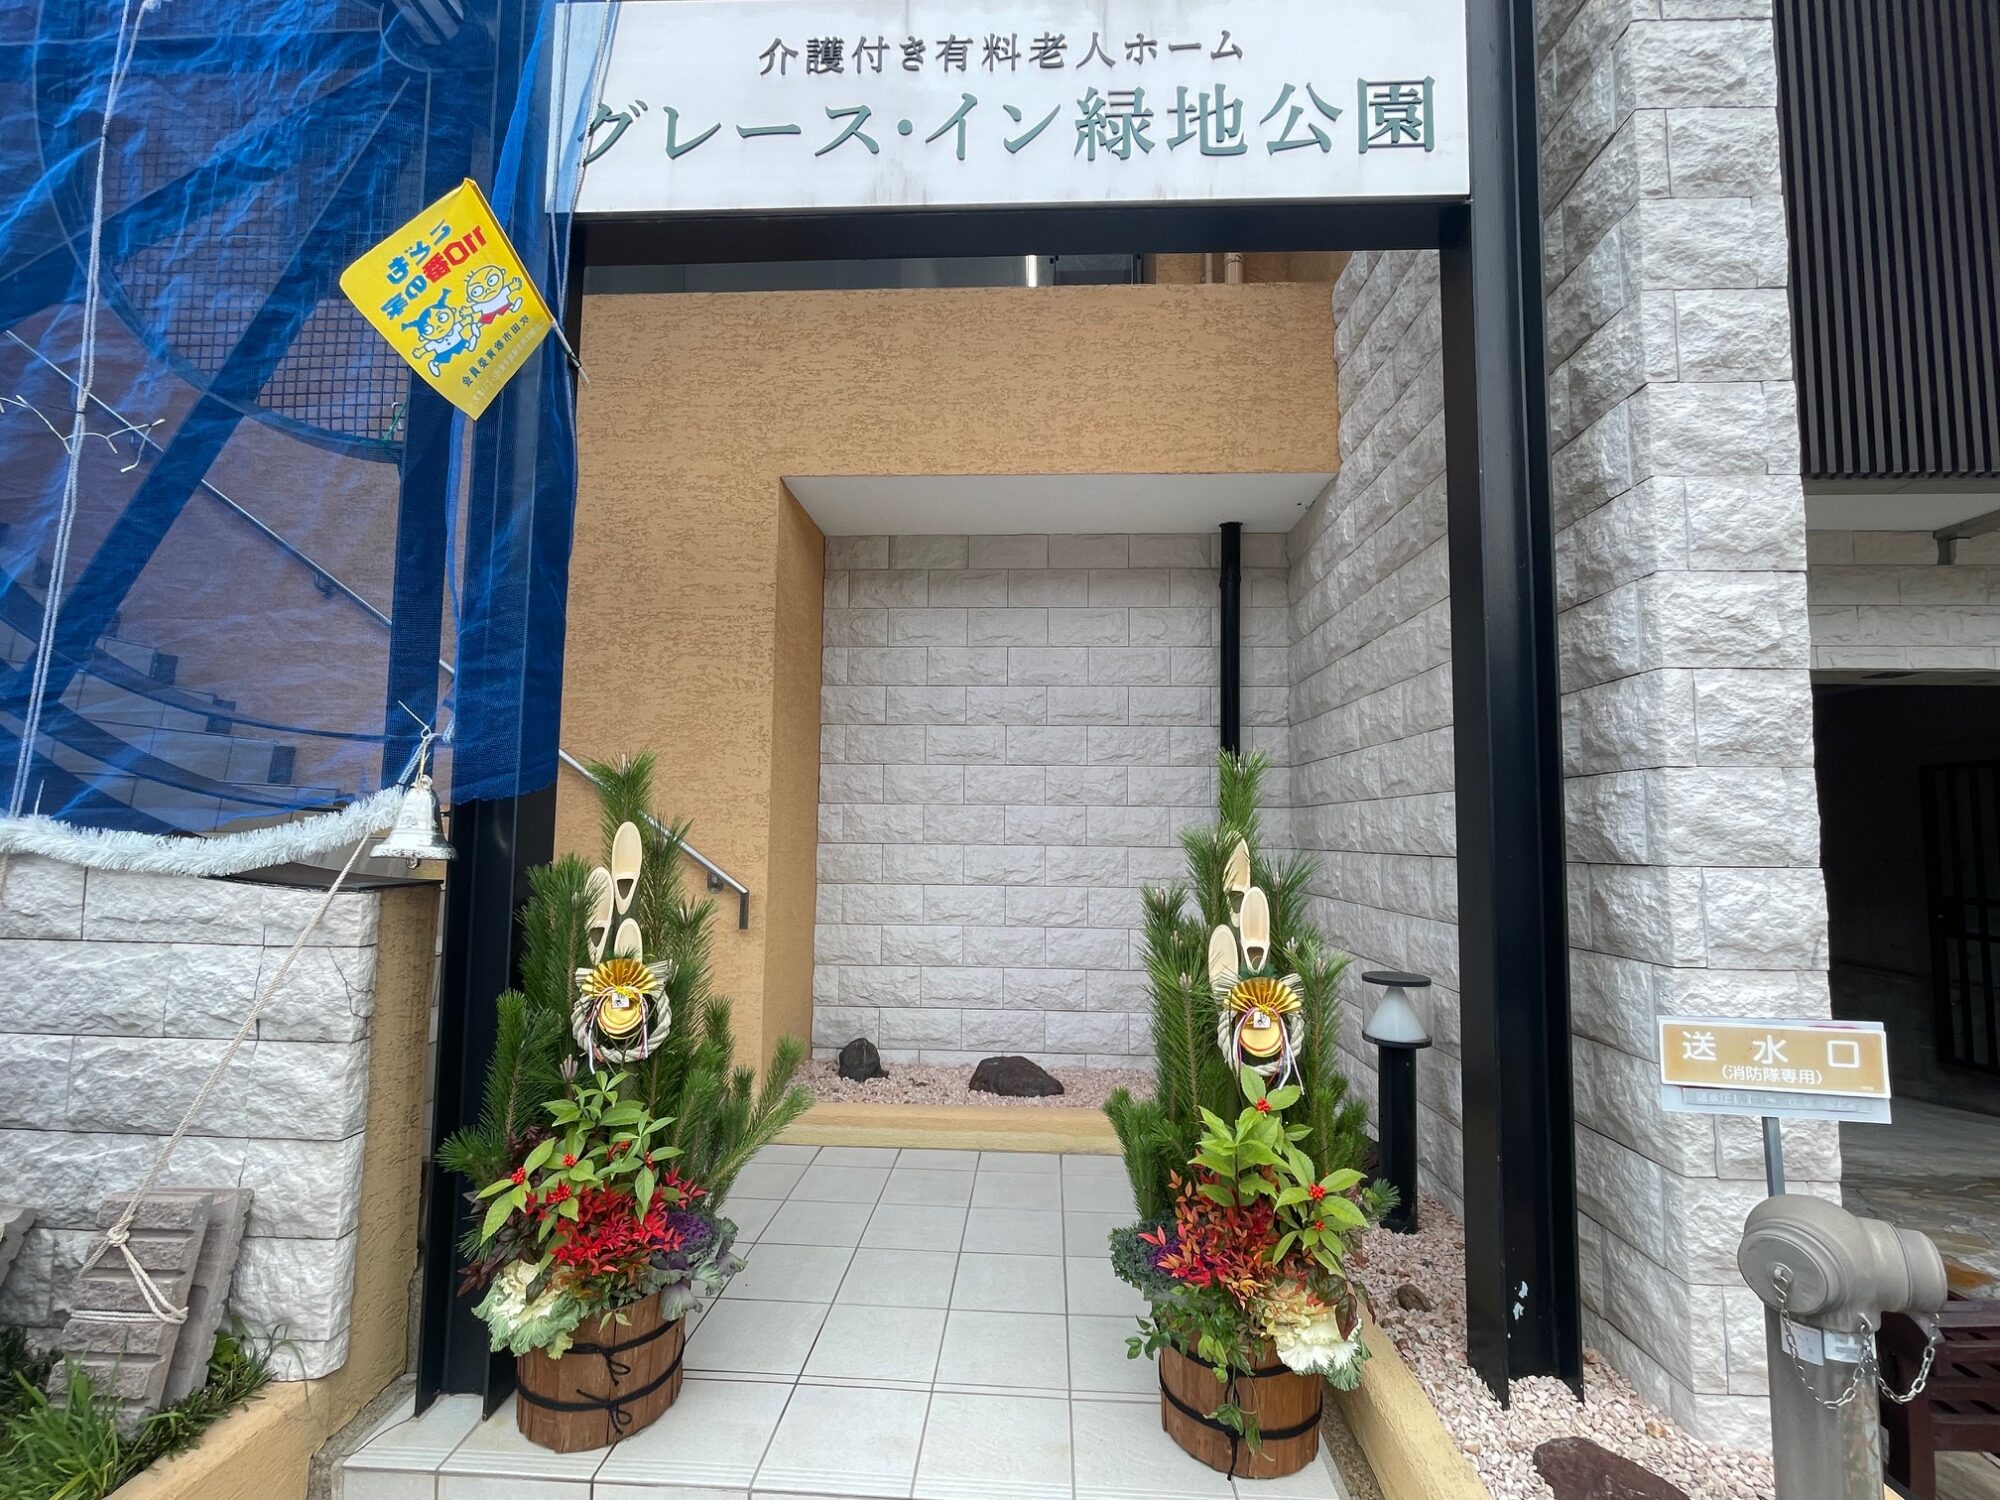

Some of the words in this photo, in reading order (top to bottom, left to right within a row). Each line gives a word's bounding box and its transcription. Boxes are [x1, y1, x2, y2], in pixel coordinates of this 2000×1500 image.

[759, 31, 1243, 75] 介護付き有料老人ホーム
[577, 77, 1435, 163] グレース・イン緑地公園
